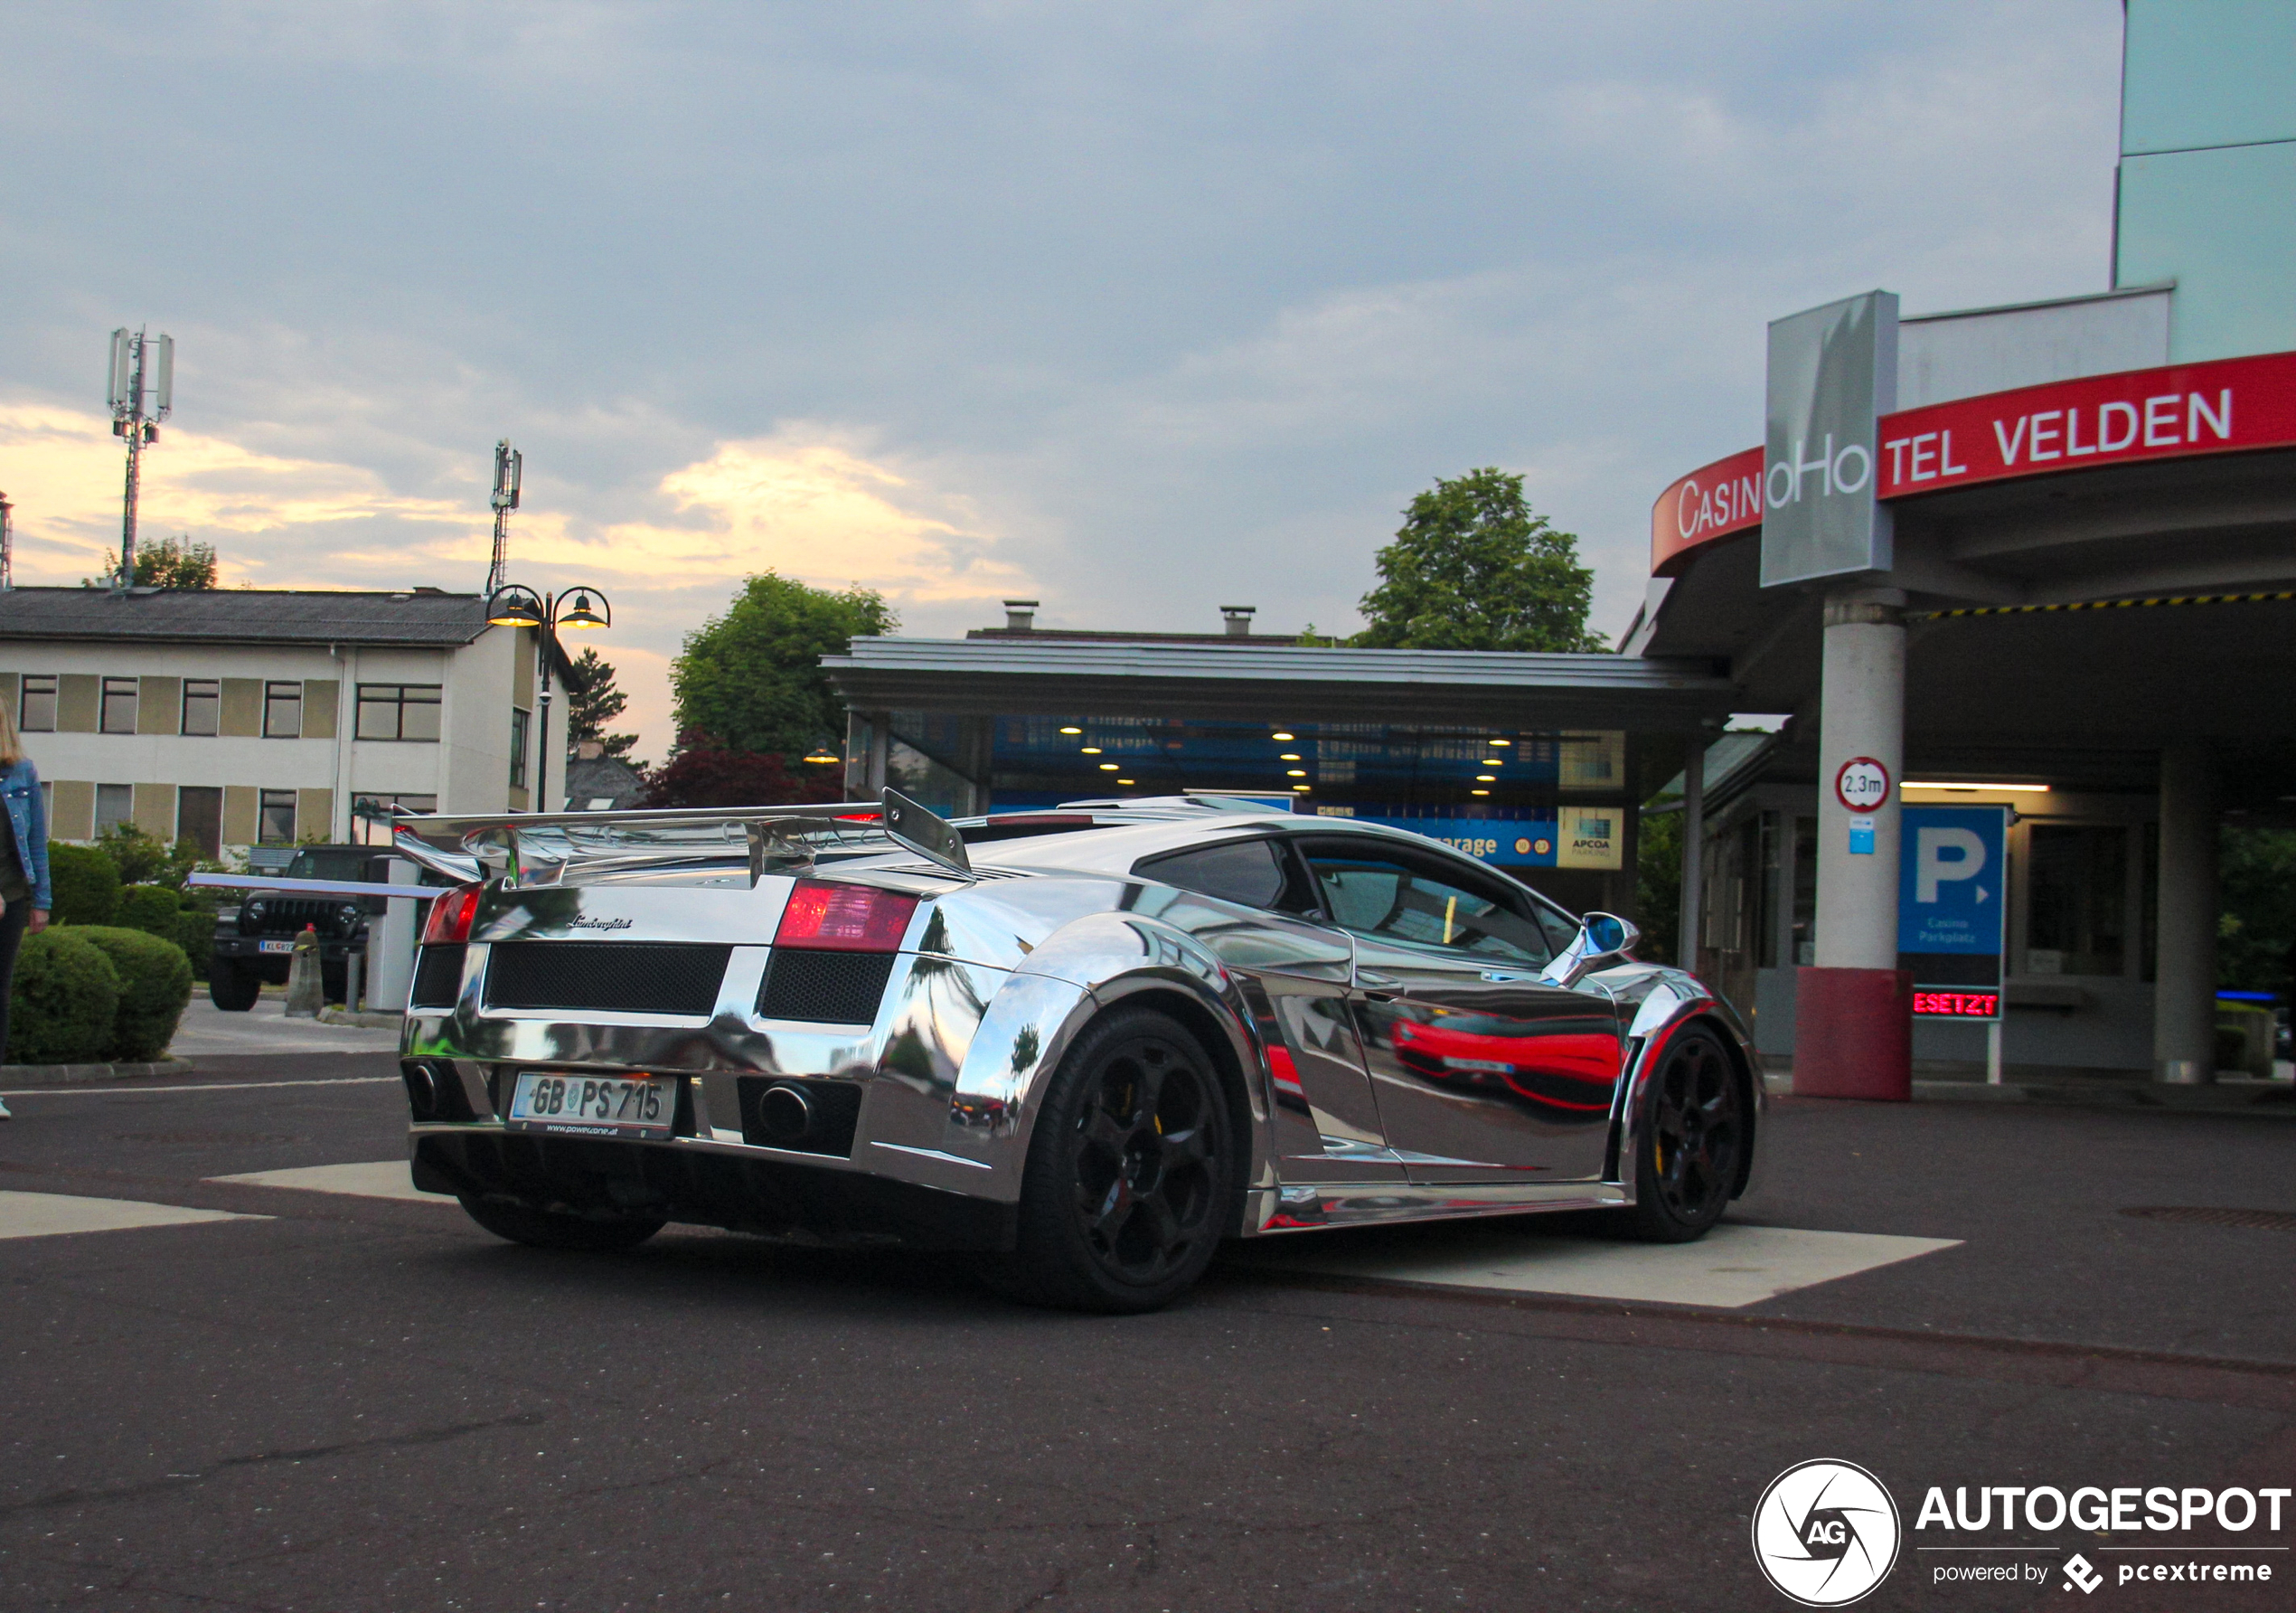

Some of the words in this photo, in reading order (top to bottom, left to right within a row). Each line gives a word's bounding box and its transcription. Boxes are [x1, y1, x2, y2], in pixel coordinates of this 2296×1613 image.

[1993, 389, 2232, 466] VELDEN
[1432, 836, 1498, 858] arage
[1573, 840, 1609, 849] APCOA
[1916, 826, 1986, 903] P
[566, 915, 633, 931] Lamborghini
[1927, 917, 1970, 929] Casino
[1918, 930, 1976, 943] Parkplatz
[1913, 993, 1998, 1015] ESETZT
[579, 1080, 614, 1118] PS
[617, 1082, 664, 1120] 715
[546, 1124, 619, 1136] www.powerzone.at
